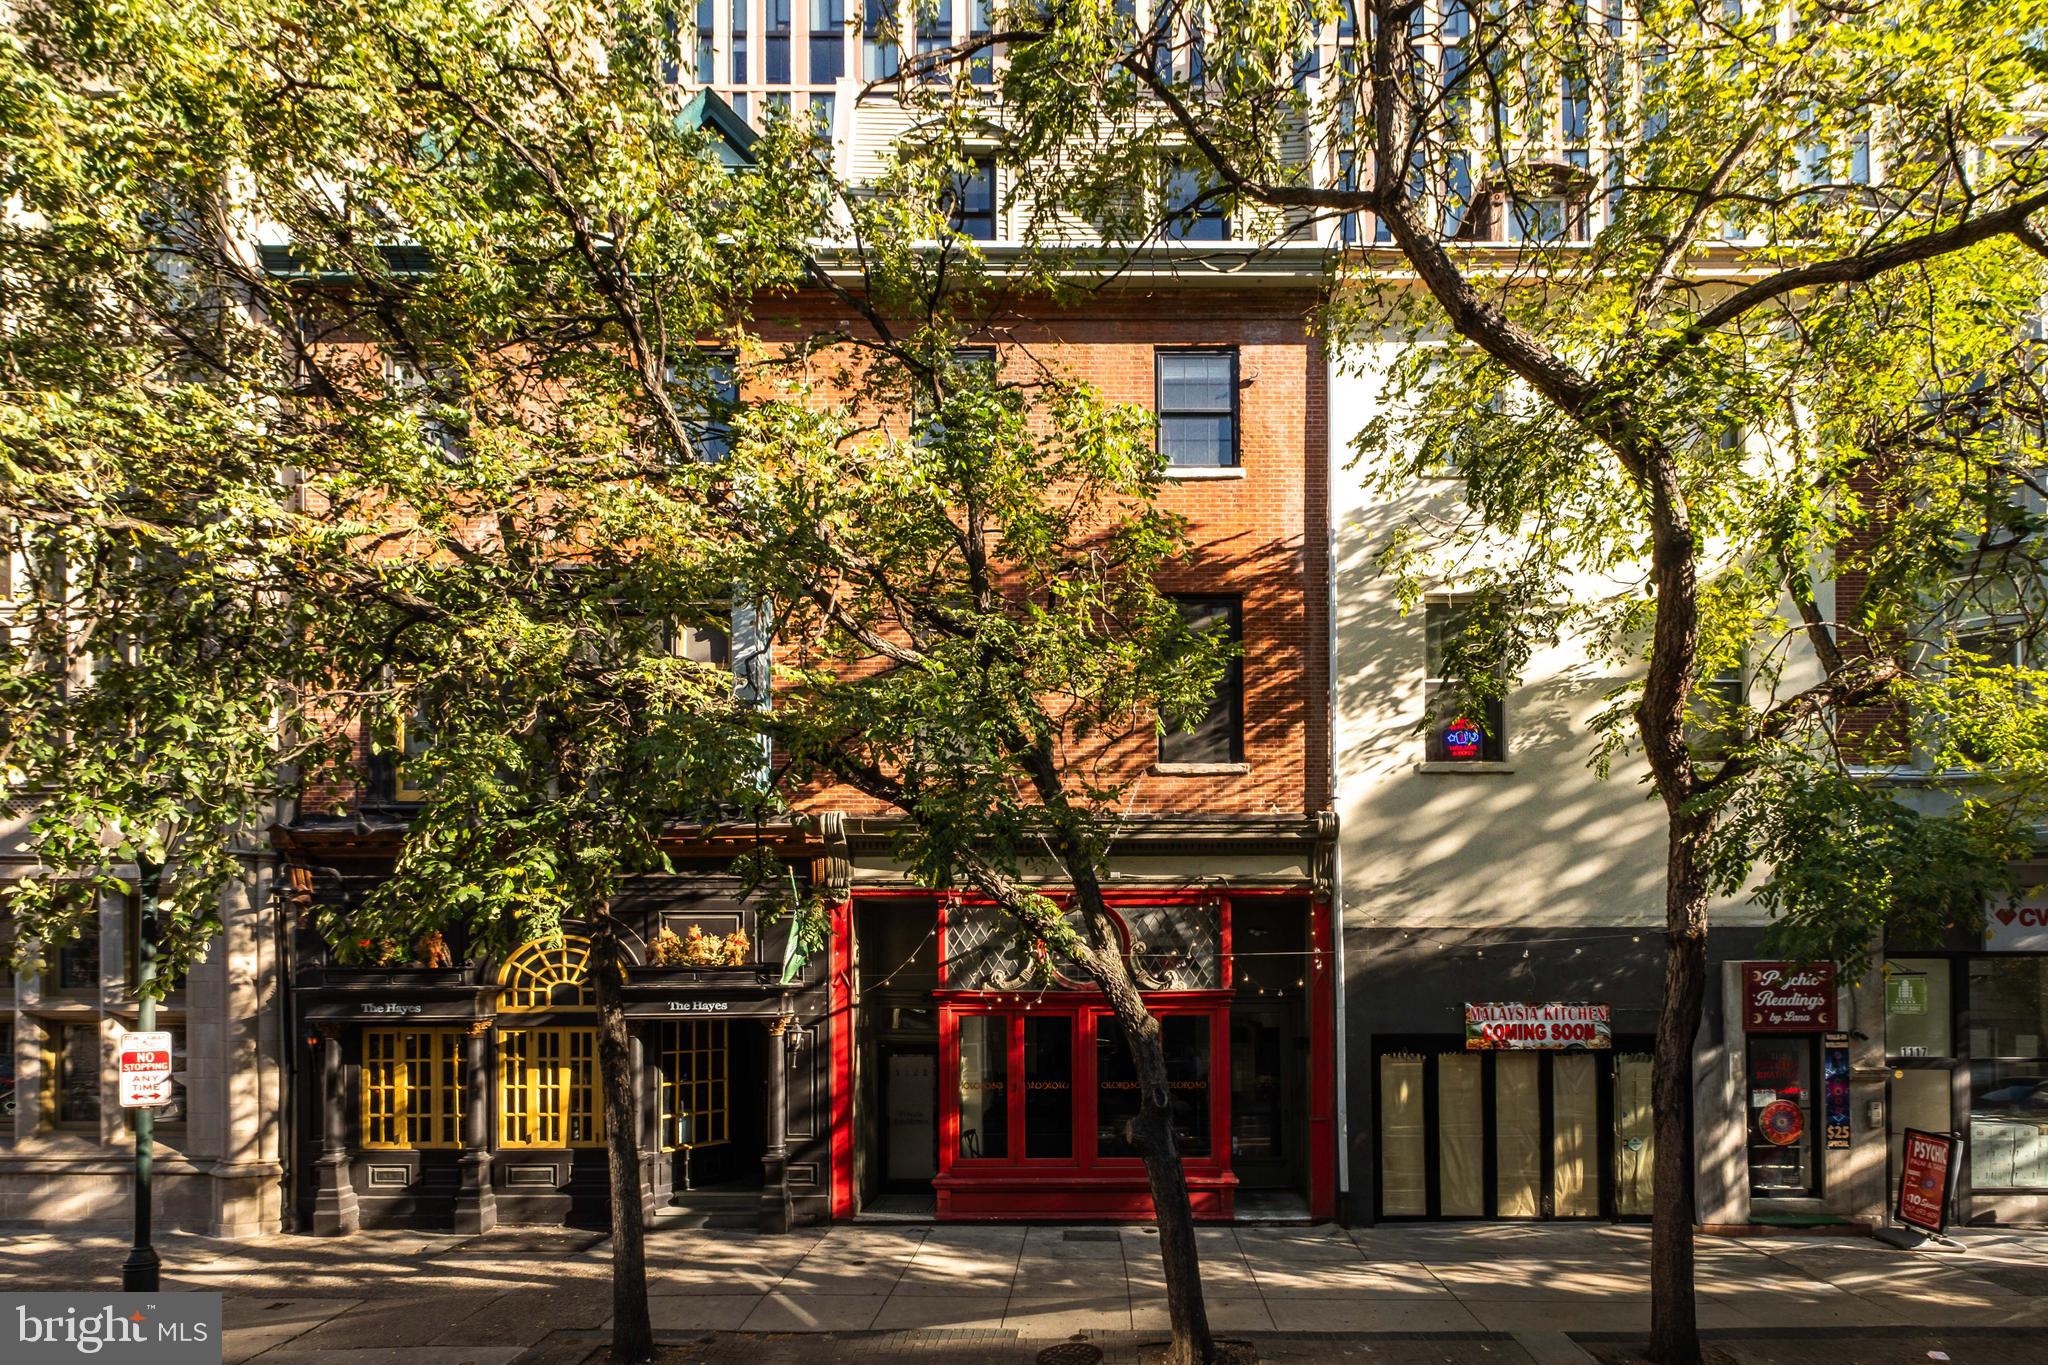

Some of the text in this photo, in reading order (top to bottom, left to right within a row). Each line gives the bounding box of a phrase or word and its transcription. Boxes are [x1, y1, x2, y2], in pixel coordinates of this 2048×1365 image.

[1760, 970, 1821, 990] Pychic
[667, 1001, 728, 1013] The Hayes
[1755, 991, 1825, 1010] Readings
[361, 1003, 421, 1015] The Hayes
[1470, 1005, 1607, 1021] MALAYSIA KITCHEN
[1769, 1012, 1782, 1024] by
[1482, 1023, 1595, 1041] COMING SOON
[136, 1051, 155, 1063] NO
[1902, 1047, 1927, 1057] 1117
[123, 1062, 168, 1071] STOPPING
[1827, 1125, 1850, 1139] $25
[1913, 1140, 1947, 1165] PSYCHIC
